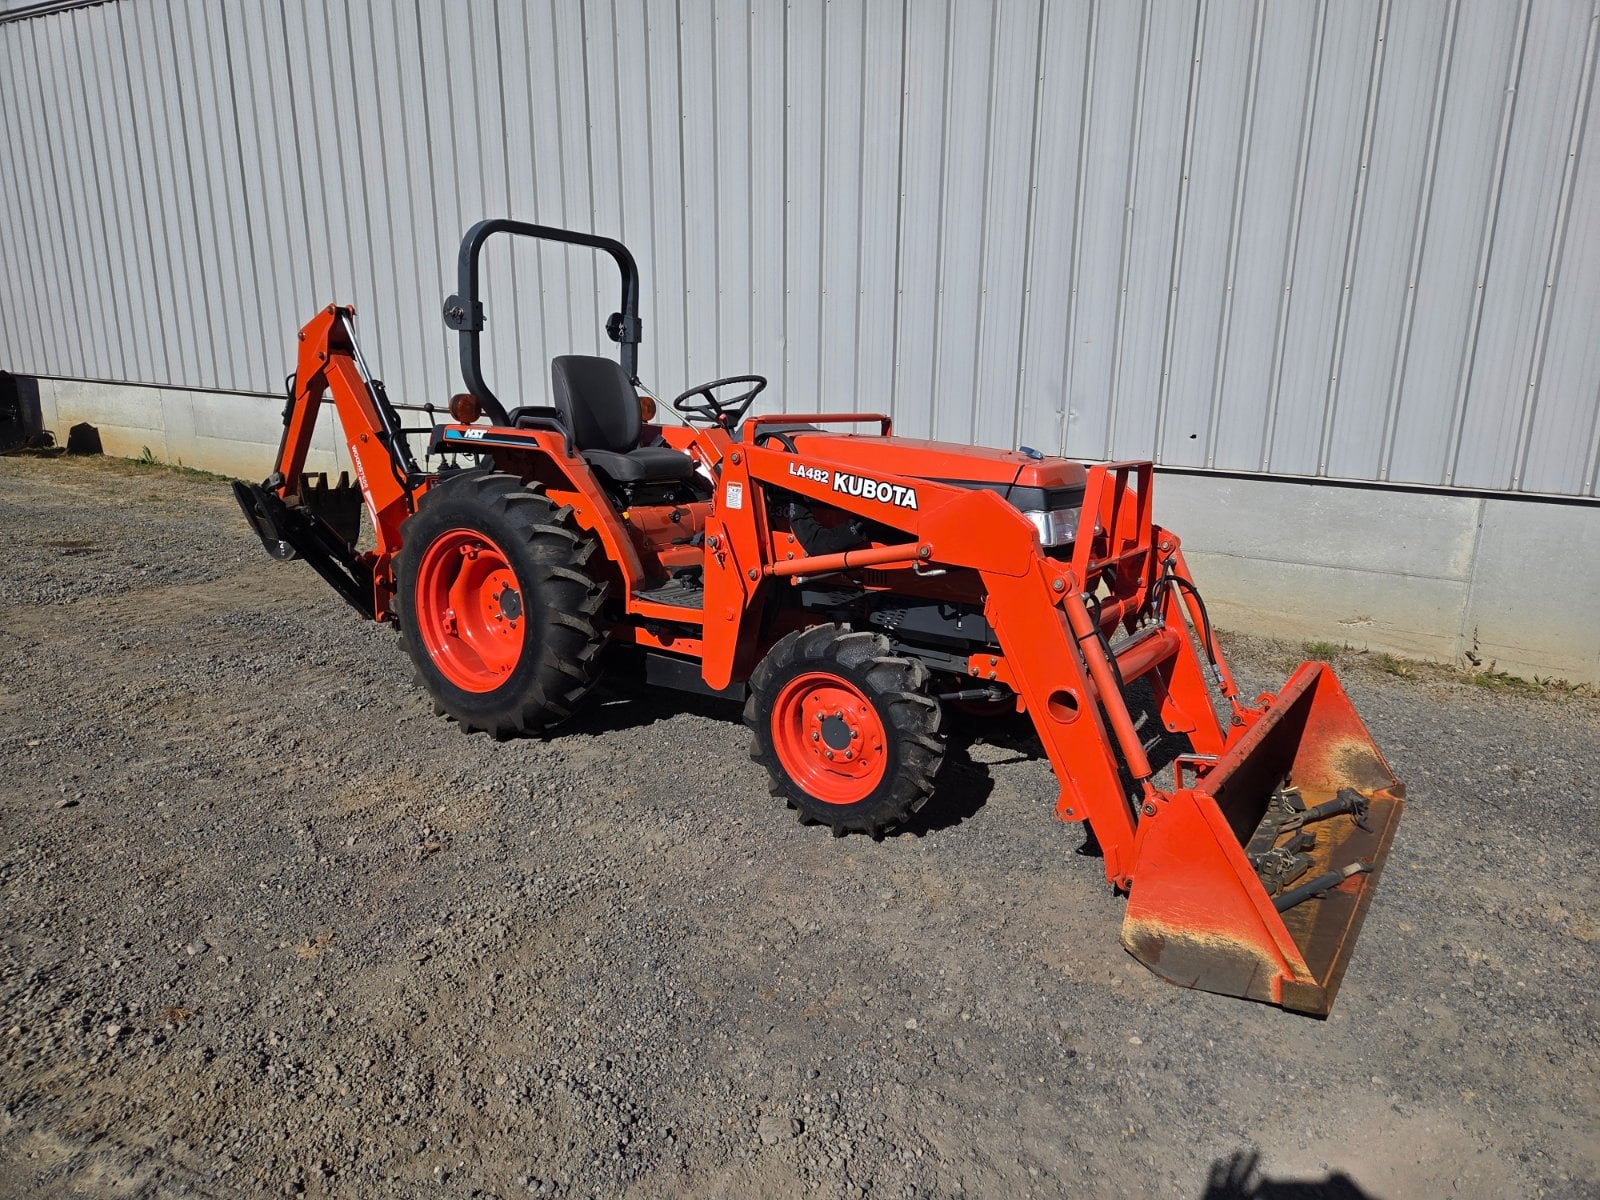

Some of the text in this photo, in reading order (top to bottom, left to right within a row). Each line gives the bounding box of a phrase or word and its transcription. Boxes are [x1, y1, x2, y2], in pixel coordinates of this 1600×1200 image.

[464, 429, 488, 439] HST
[351, 444, 364, 472] WOODS
[788, 462, 918, 511] LA482 KUBOTA
